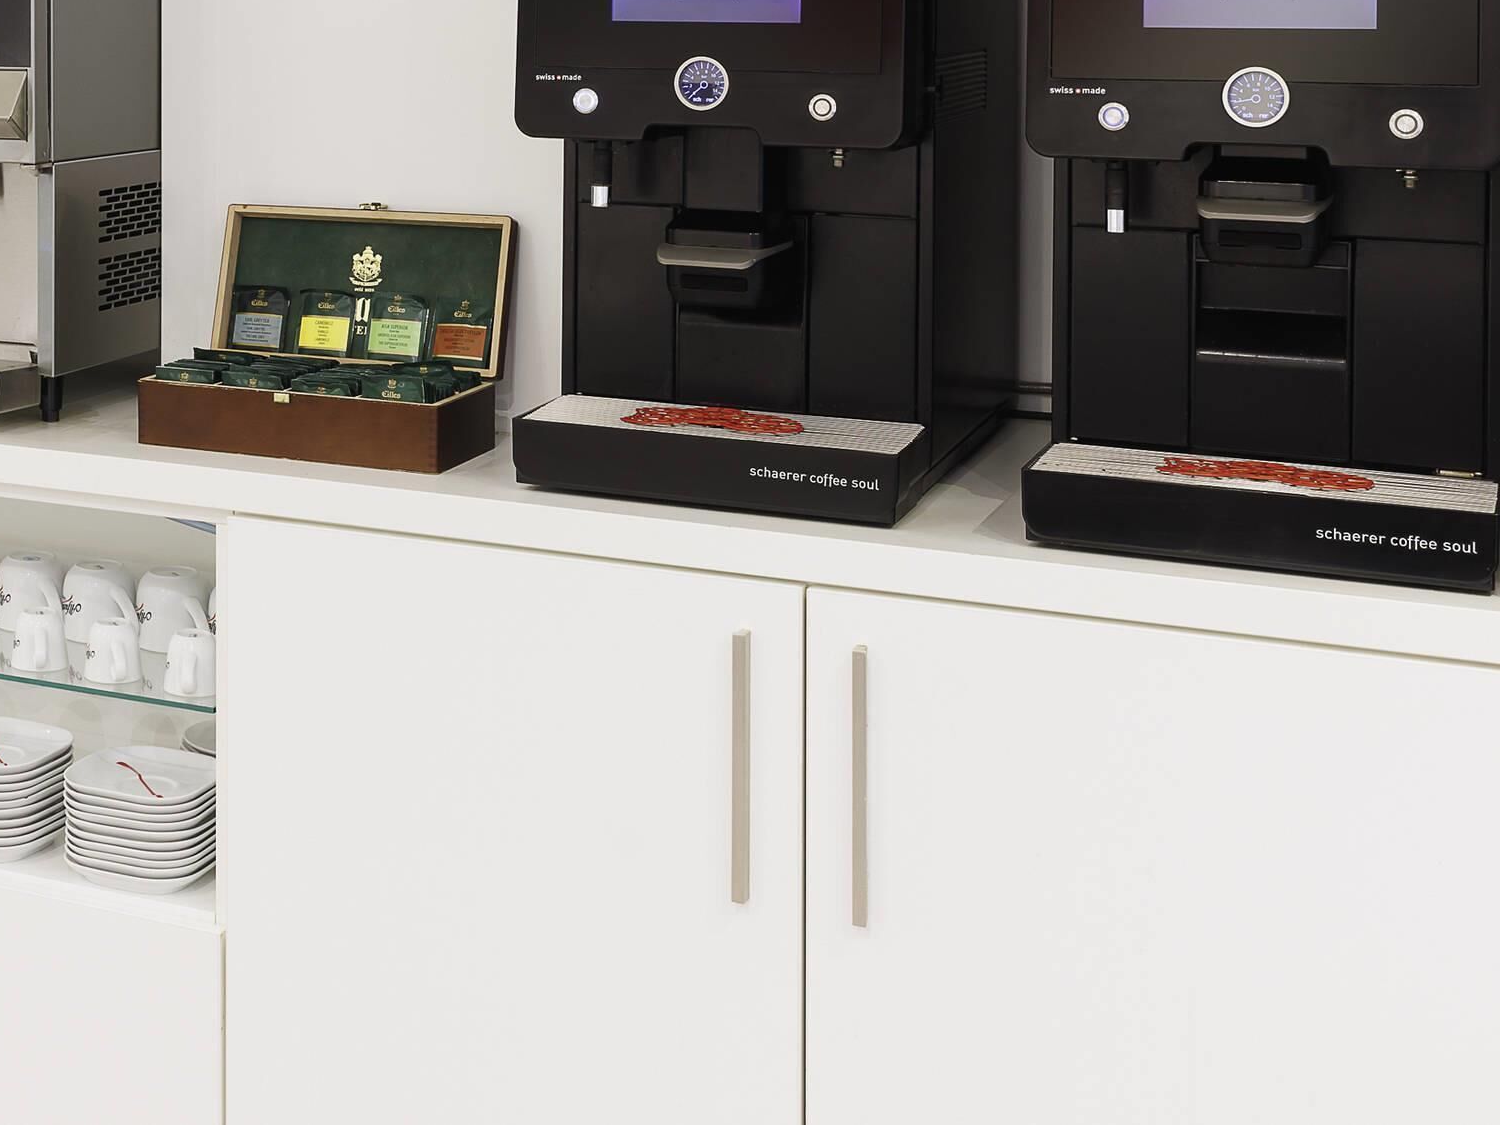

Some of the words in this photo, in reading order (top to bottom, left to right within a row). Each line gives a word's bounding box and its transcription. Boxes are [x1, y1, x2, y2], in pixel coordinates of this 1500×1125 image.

[535, 73, 555, 81] swiss
[1049, 86, 1074, 94] swiss
[1082, 86, 1106, 95] made
[749, 466, 806, 482] schaerer
[809, 473, 848, 488] coffee
[851, 476, 879, 490] soul
[1315, 527, 1386, 546] schaerer
[1390, 534, 1437, 551] coffee
[1442, 538, 1478, 554] soul
